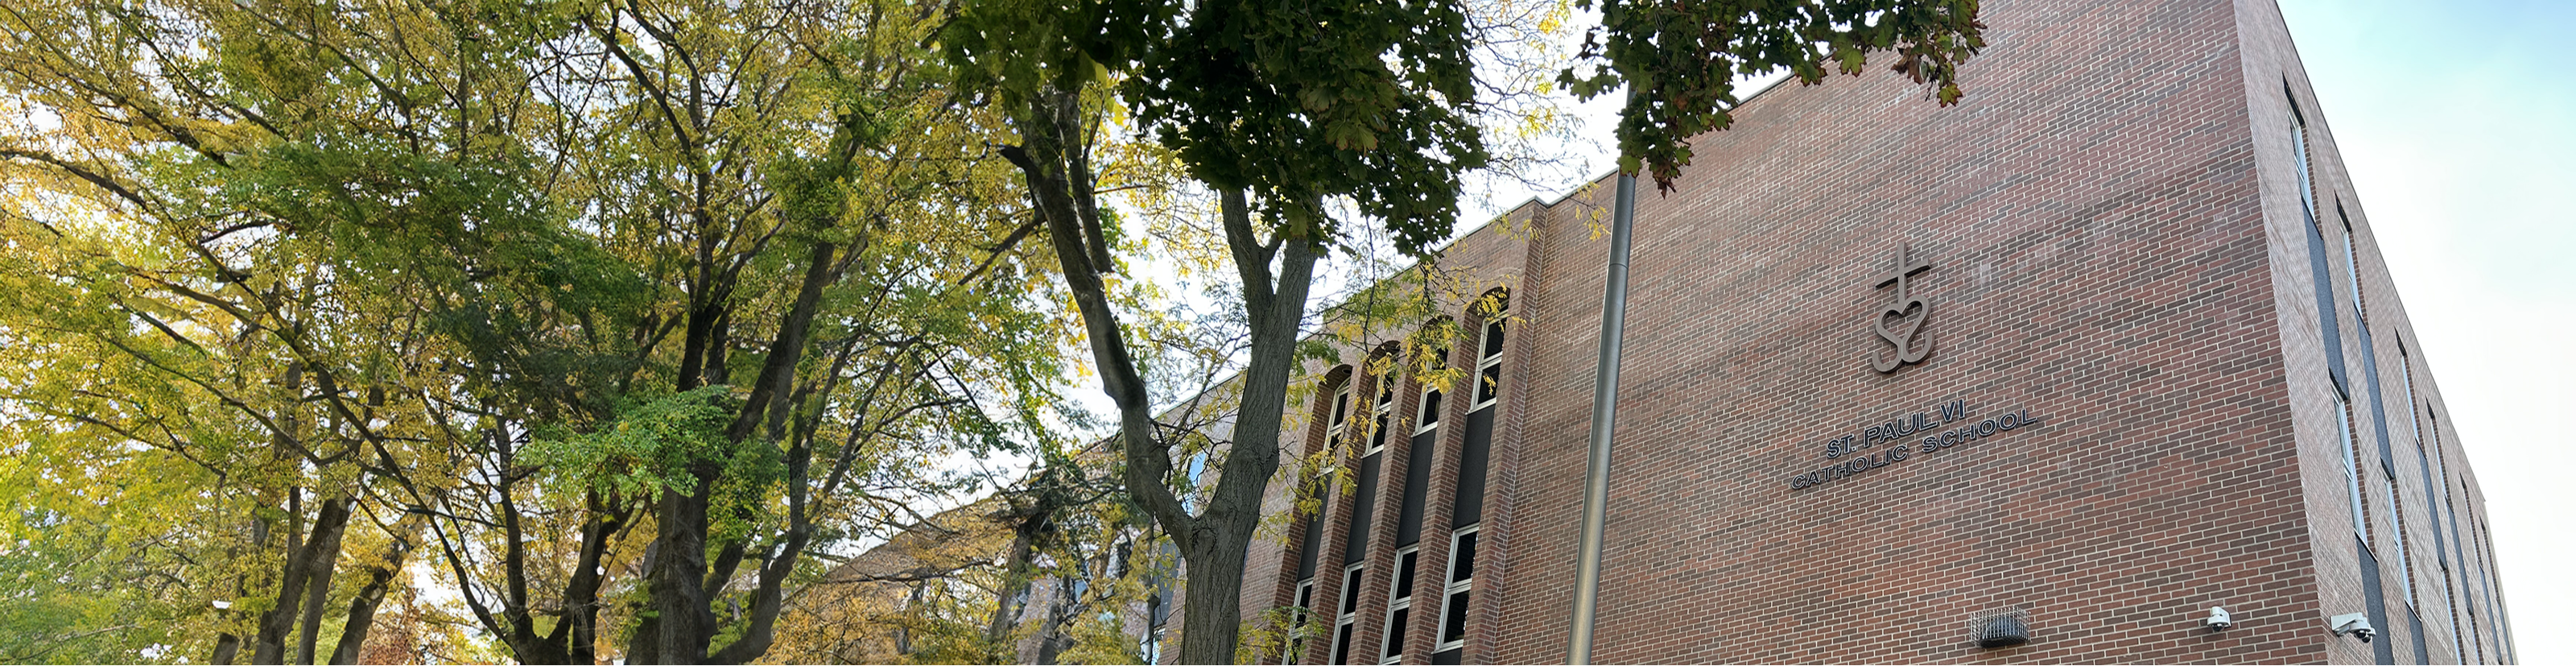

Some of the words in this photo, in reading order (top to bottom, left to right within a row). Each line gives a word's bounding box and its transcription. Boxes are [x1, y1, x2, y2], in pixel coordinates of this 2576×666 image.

[1790, 444, 1909, 490] CATHOLIC
[1922, 408, 2037, 453] SCHOOL
[1826, 434, 1857, 459] ST.
[1863, 412, 1938, 448] PAUL
[1940, 399, 1966, 423] VI
